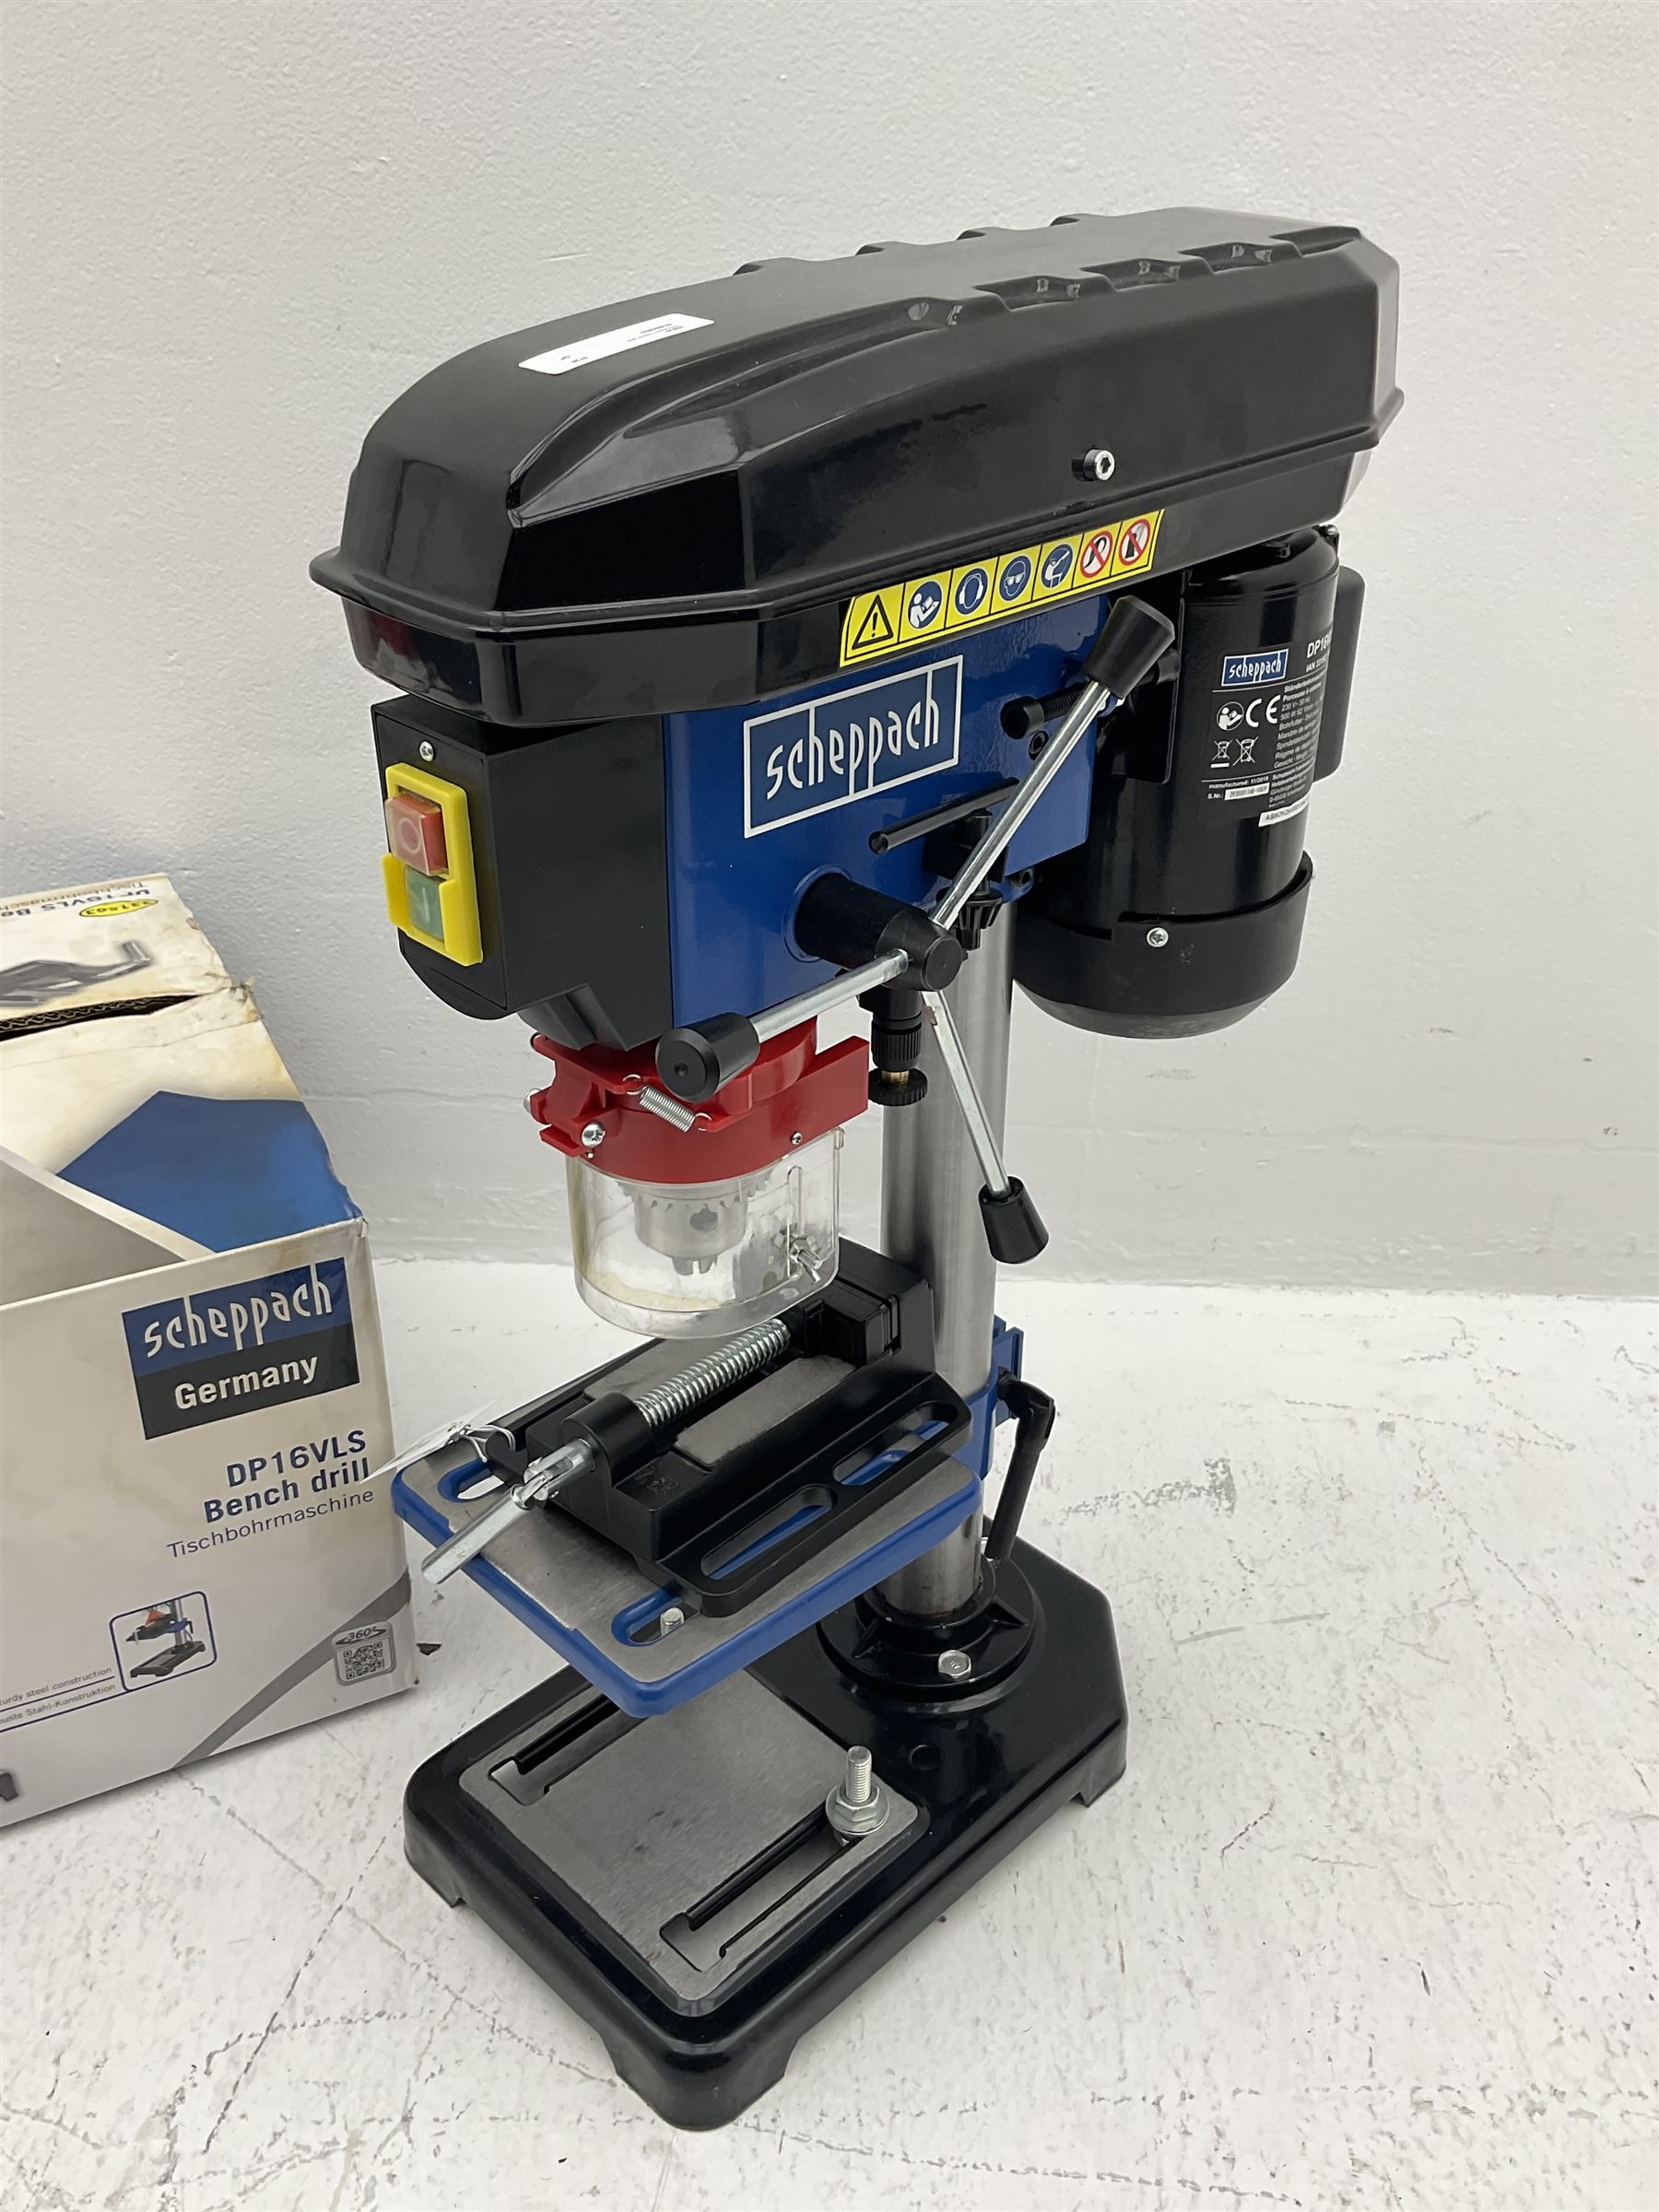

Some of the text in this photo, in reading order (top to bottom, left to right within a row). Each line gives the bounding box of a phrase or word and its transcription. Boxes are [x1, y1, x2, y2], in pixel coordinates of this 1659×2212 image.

[1229, 652, 1282, 682] scheppach
[766, 670, 940, 800] scheppach
[145, 1265, 333, 1358] scheppach
[174, 1356, 318, 1409] Germany
[226, 1430, 367, 1488] DP16VLS
[204, 1457, 370, 1524] Bench drill
[167, 1490, 375, 1558] Tischbohrmaschine
[25, 1684, 116, 1716] Stahl-Konstruktion
[26, 1685, 50, 1697] steel
[52, 1666, 112, 1690] construction
